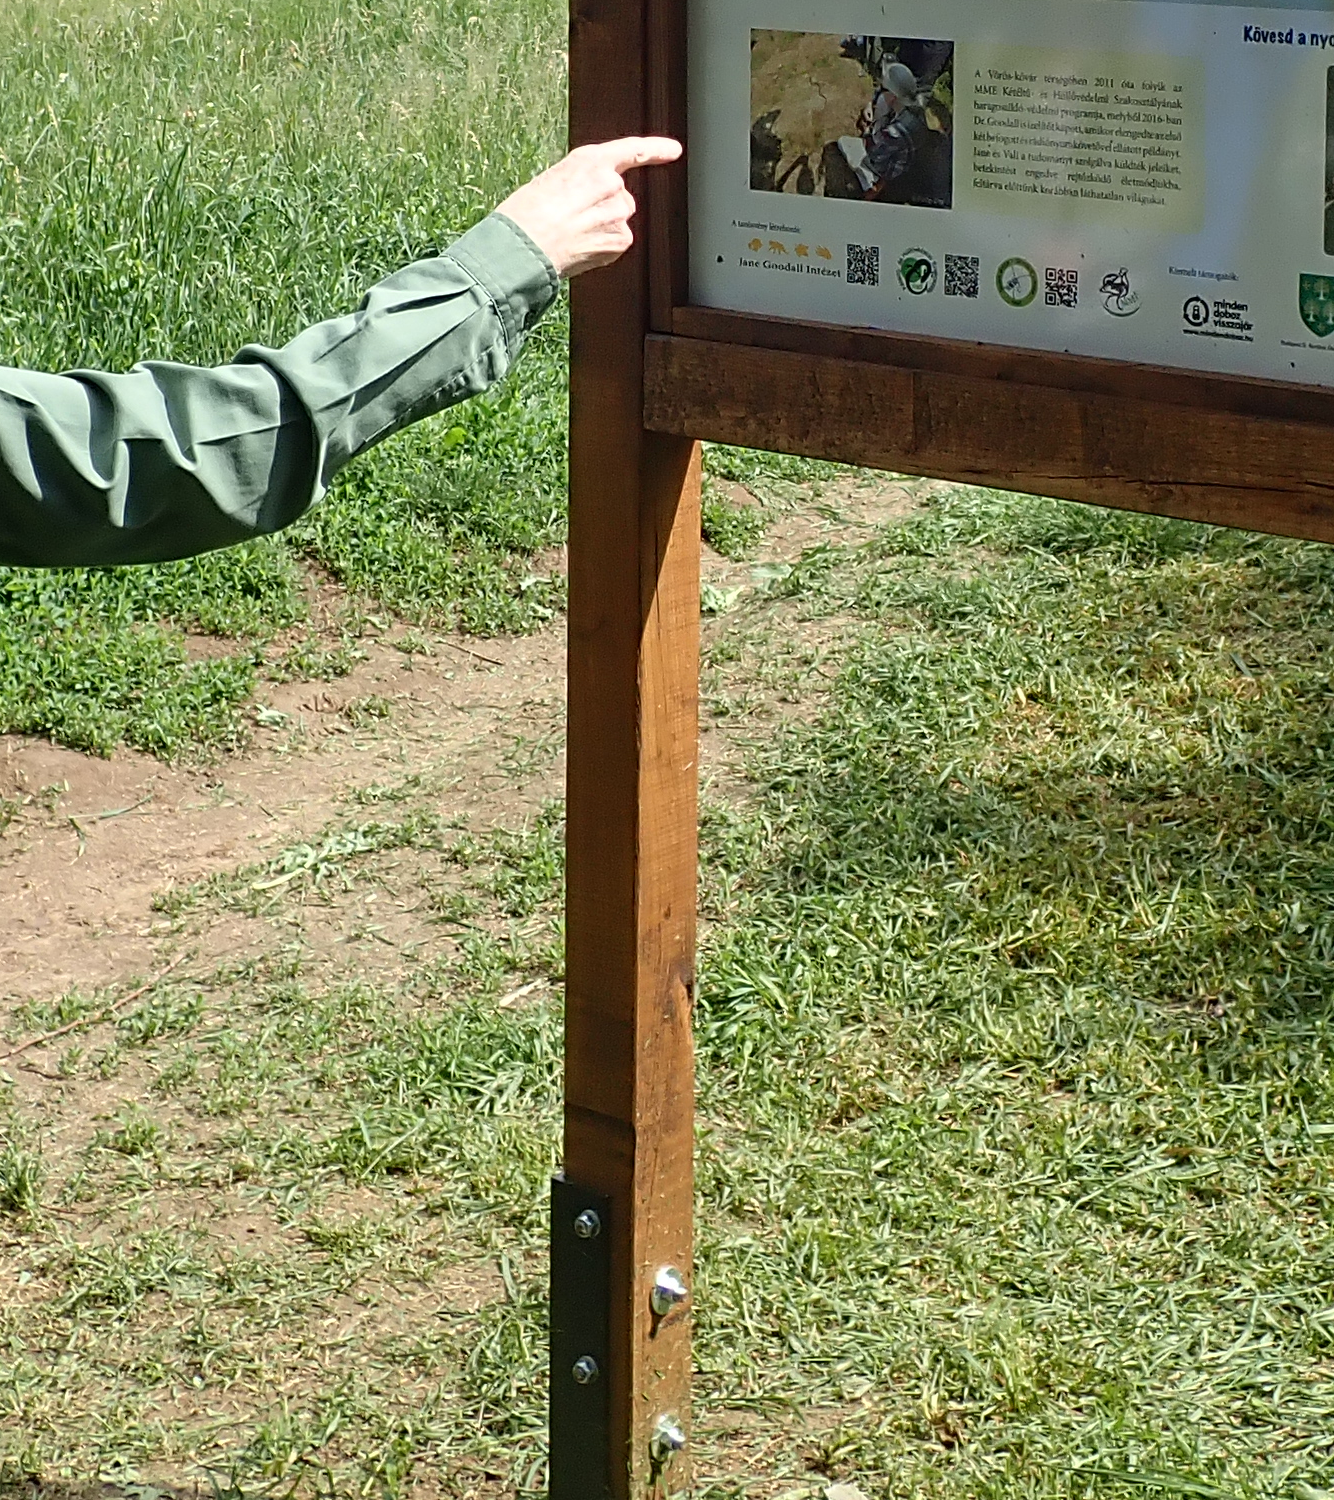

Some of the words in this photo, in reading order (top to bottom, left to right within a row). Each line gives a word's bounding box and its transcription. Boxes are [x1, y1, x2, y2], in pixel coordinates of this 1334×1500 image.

[1243, 26, 1293, 44] Kövesd
[1298, 32, 1306, 44] a
[974, 69, 981, 78] A
[1094, 77, 1114, 88] 2011
[974, 85, 997, 96] MME
[739, 258, 760, 267] Jane
[763, 260, 803, 273] Goodall
[806, 266, 841, 277] Intézet
[1213, 299, 1248, 311] minden
[1213, 310, 1241, 319] doboz
